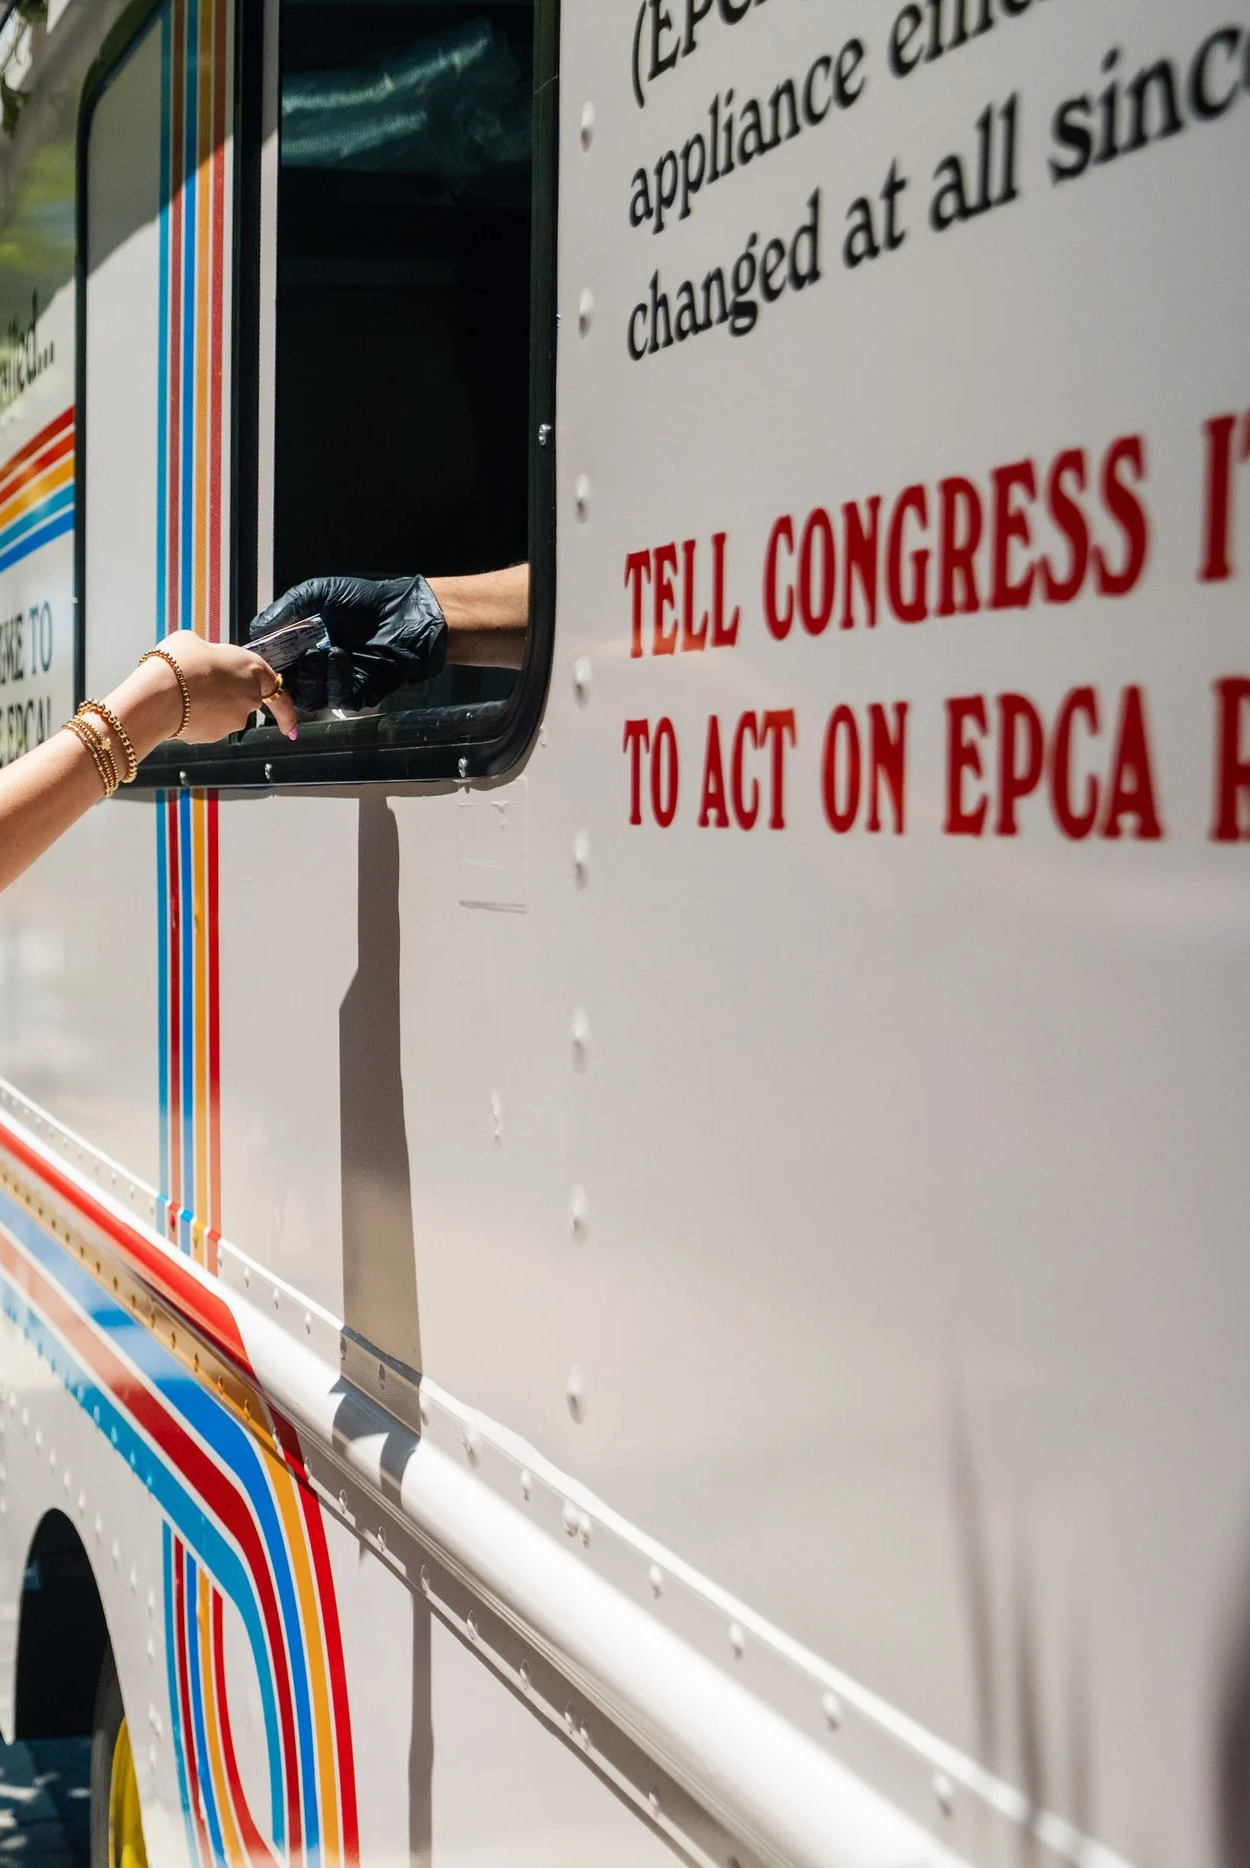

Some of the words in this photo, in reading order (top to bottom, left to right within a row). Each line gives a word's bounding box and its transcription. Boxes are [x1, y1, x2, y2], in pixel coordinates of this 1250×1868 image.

[626, 187, 822, 361] changed
[843, 160, 908, 269] at
[929, 91, 1020, 232] all
[1048, 24, 1250, 183] sinc
[628, 37, 866, 235] appliance
[29, 601, 53, 676] TO
[624, 531, 740, 659] TELL
[762, 433, 1151, 641] CONGRESS
[622, 716, 680, 829] TO
[697, 708, 797, 832] ACT
[820, 700, 909, 836] ON
[943, 684, 1166, 842] EPCA
